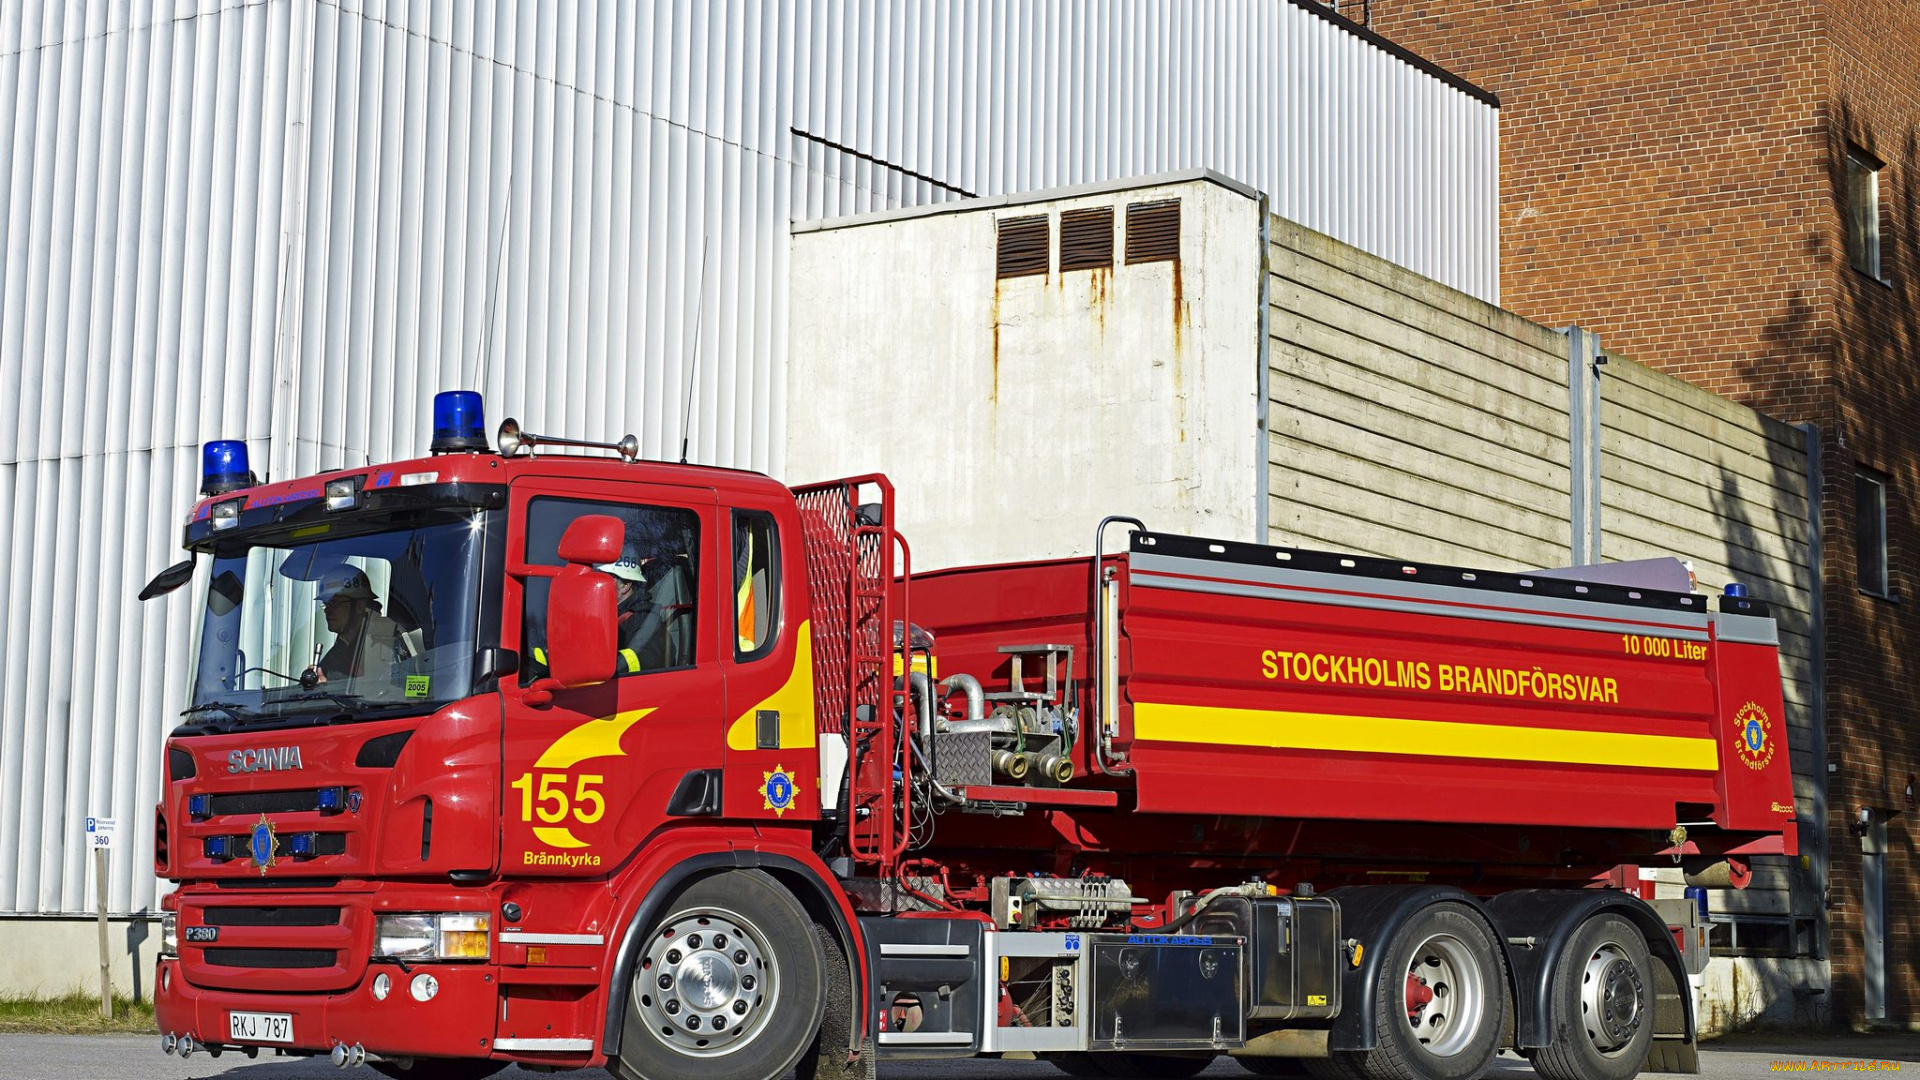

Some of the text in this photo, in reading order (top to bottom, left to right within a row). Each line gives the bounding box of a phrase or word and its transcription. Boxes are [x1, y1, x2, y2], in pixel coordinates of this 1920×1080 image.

[615, 556, 637, 569] 268
[1622, 635, 1707, 661] 10 000 Liter
[408, 684, 426, 692] 2005
[1261, 650, 1619, 704] STOCKHOLMS BRANDFÖRSVAR
[1733, 700, 1772, 731] Stockholms
[227, 746, 303, 774] SCANIA
[1734, 738, 1775, 771] Brandförsvar
[511, 772, 606, 824] 155
[94, 835, 110, 846] 360
[523, 851, 601, 868] Brännkyrka
[185, 927, 217, 941] P380
[1127, 935, 1213, 945] AUTOKAROSS
[232, 1015, 288, 1039] RKJ 787
